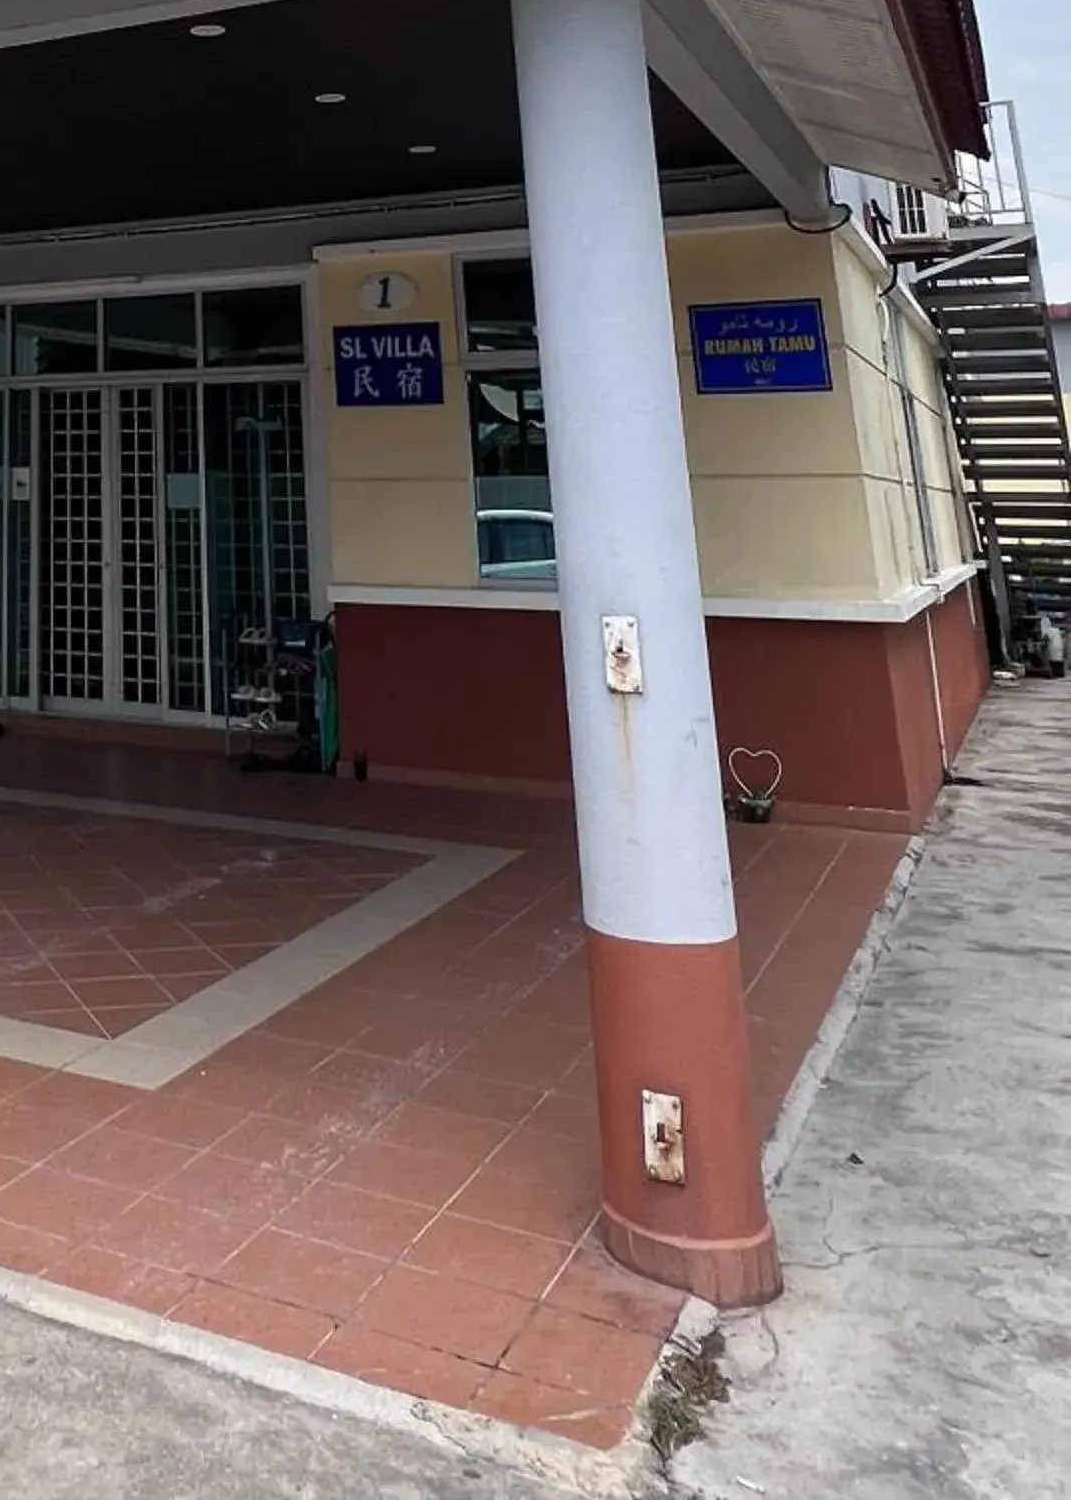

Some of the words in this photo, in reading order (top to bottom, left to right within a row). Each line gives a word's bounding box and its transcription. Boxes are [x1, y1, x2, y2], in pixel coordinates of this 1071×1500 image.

[377, 276, 392, 309] 1
[340, 336, 367, 359] SL
[371, 334, 434, 358] VILLA
[704, 337, 763, 356] RUMAH
[768, 334, 816, 353] TAMU
[353, 362, 423, 399] 民宿
